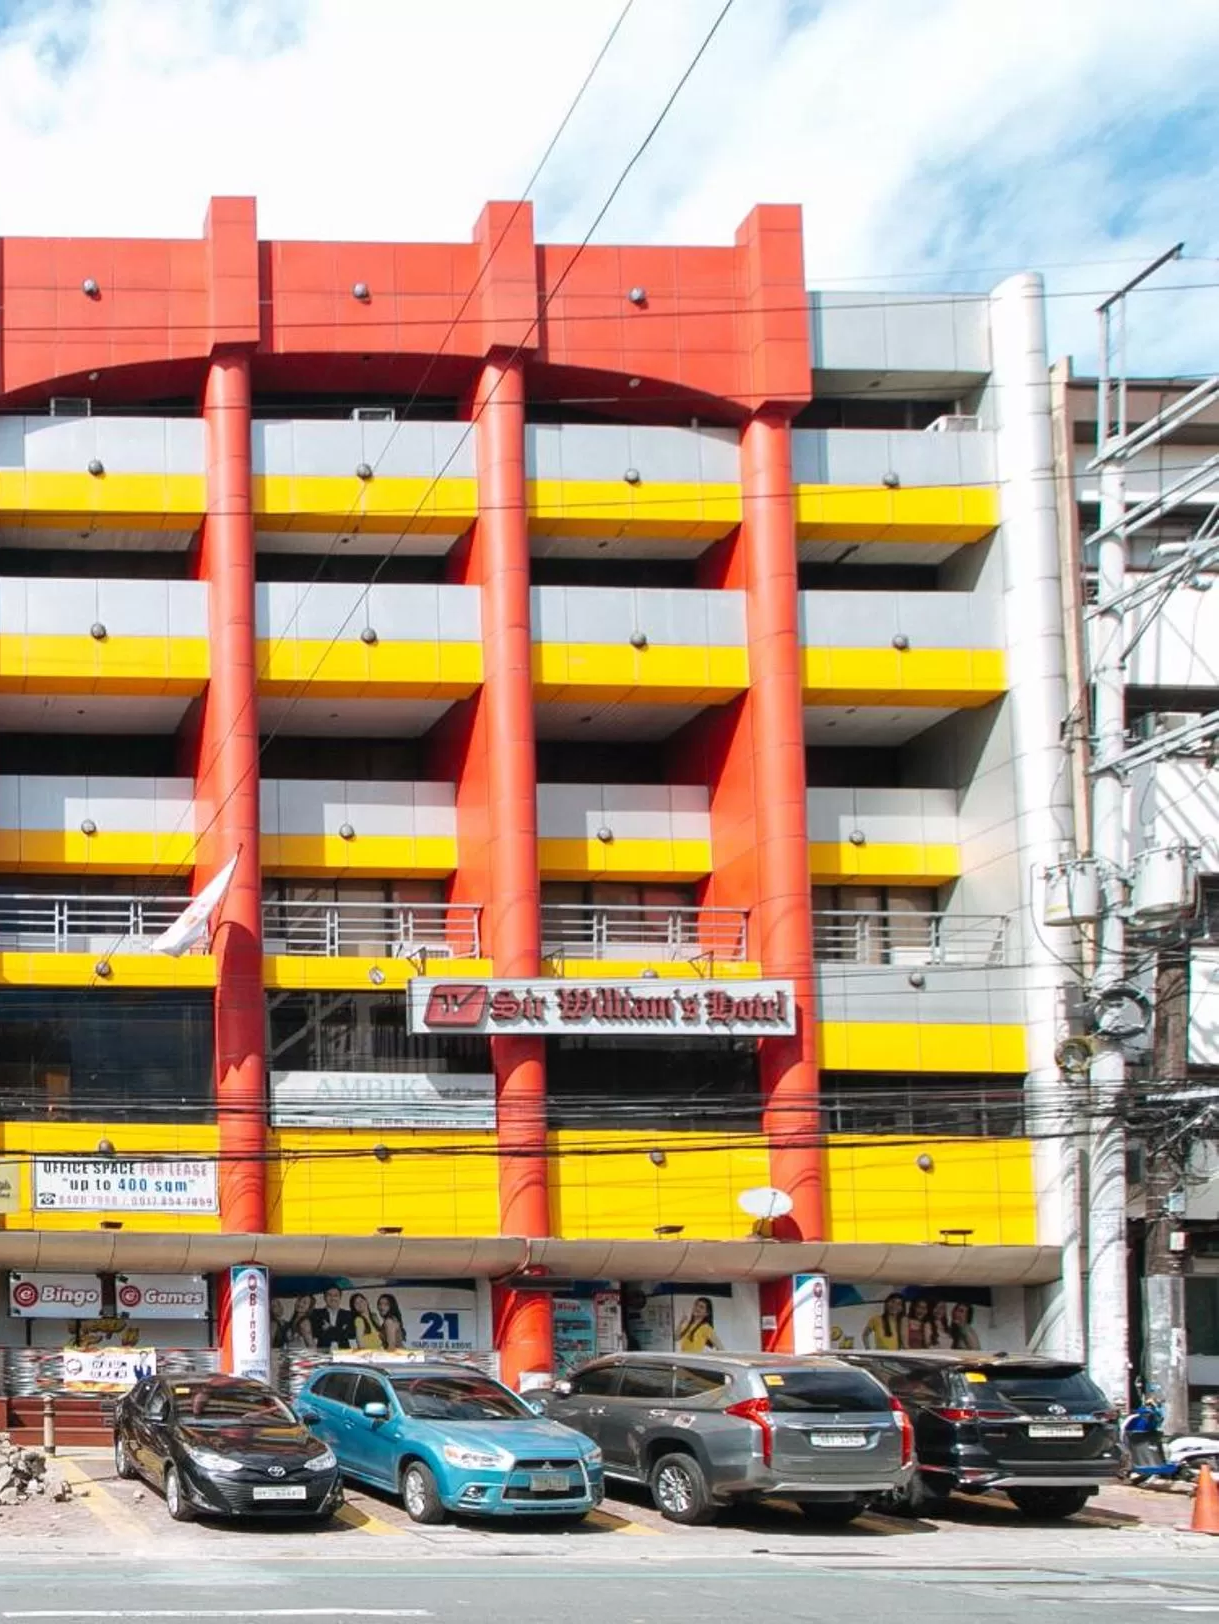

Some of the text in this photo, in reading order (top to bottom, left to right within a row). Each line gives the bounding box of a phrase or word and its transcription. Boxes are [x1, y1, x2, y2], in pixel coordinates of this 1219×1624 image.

[489, 988, 549, 1023] Sir
[704, 989, 789, 1030] Hotel
[93, 1161, 136, 1175] SPACE
[96, 1178, 112, 1191] to
[118, 1178, 148, 1192] 400
[41, 1287, 98, 1307] Bingo
[144, 1289, 205, 1304] Games
[420, 1311, 460, 1340] 21
